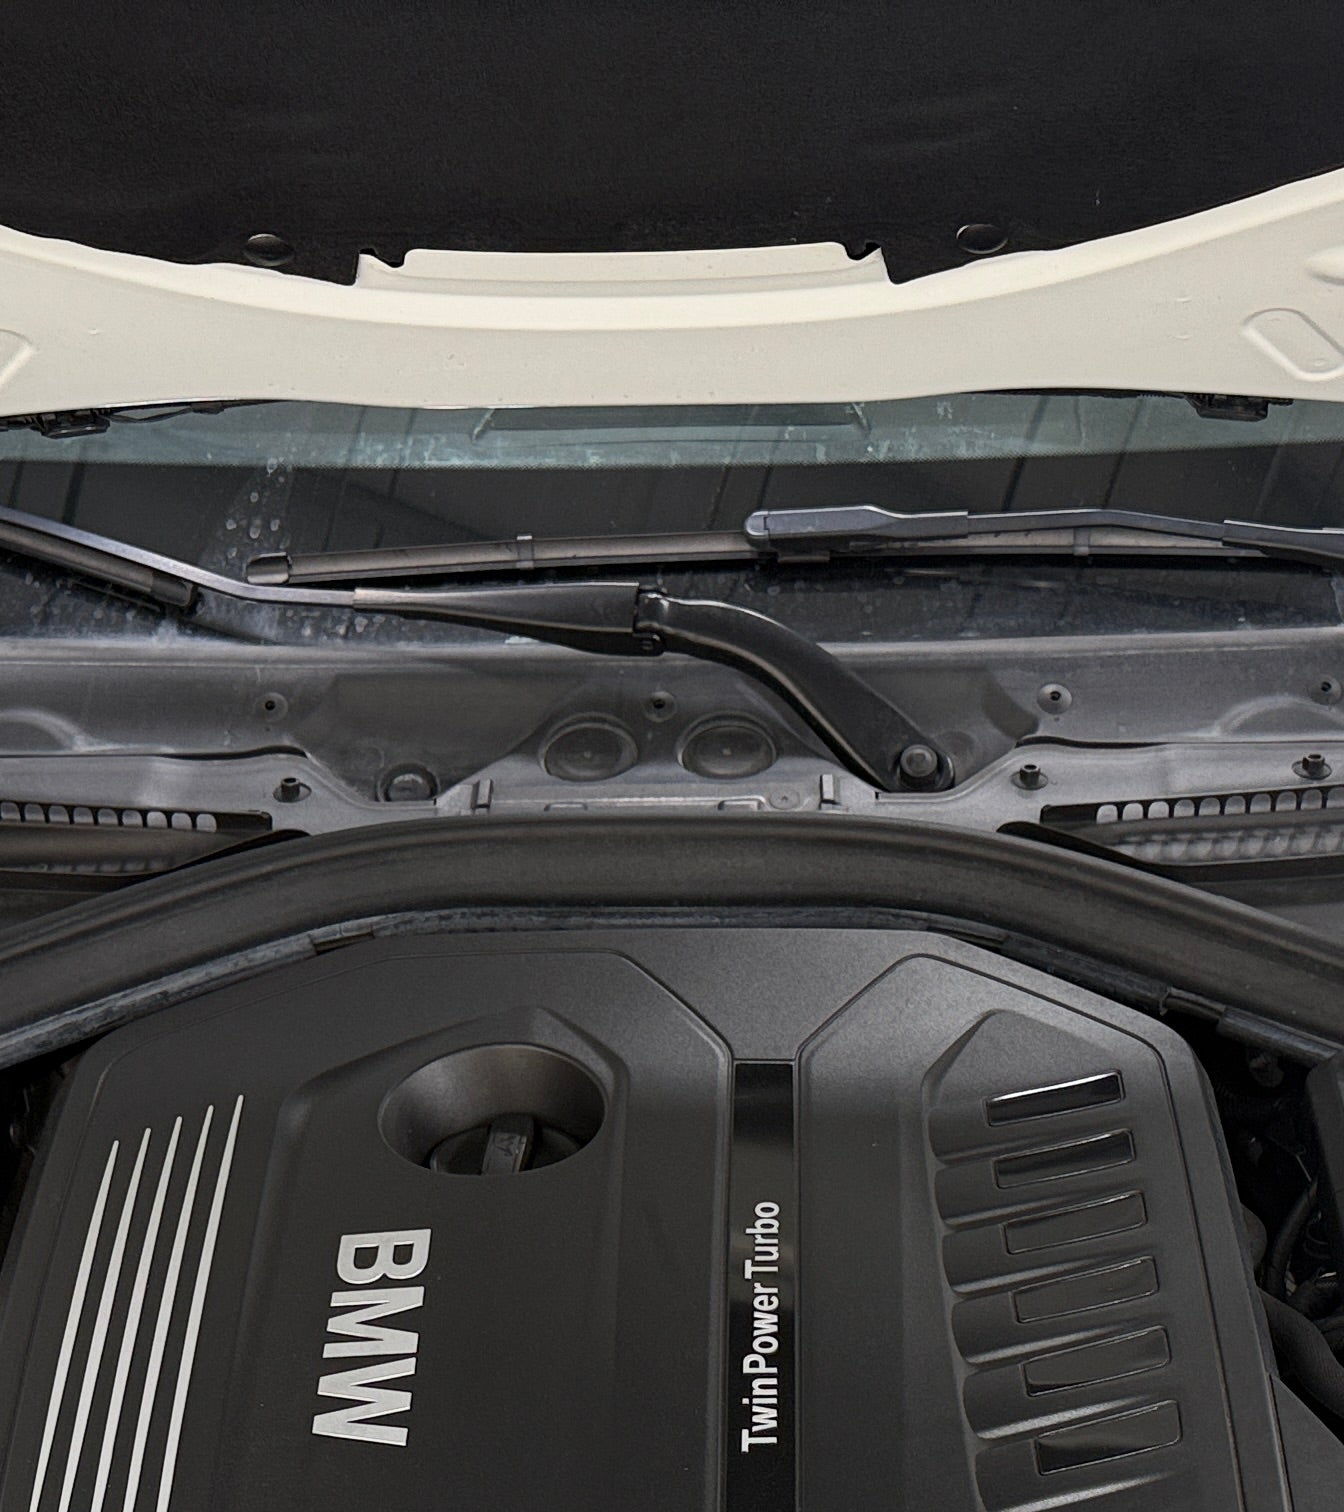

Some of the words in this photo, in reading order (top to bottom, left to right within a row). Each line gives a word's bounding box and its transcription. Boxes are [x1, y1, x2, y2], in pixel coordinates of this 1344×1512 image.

[744, 1200, 779, 1280] Turbo
[311, 1228, 432, 1447] BMW
[741, 1282, 779, 1453] TwinPower
